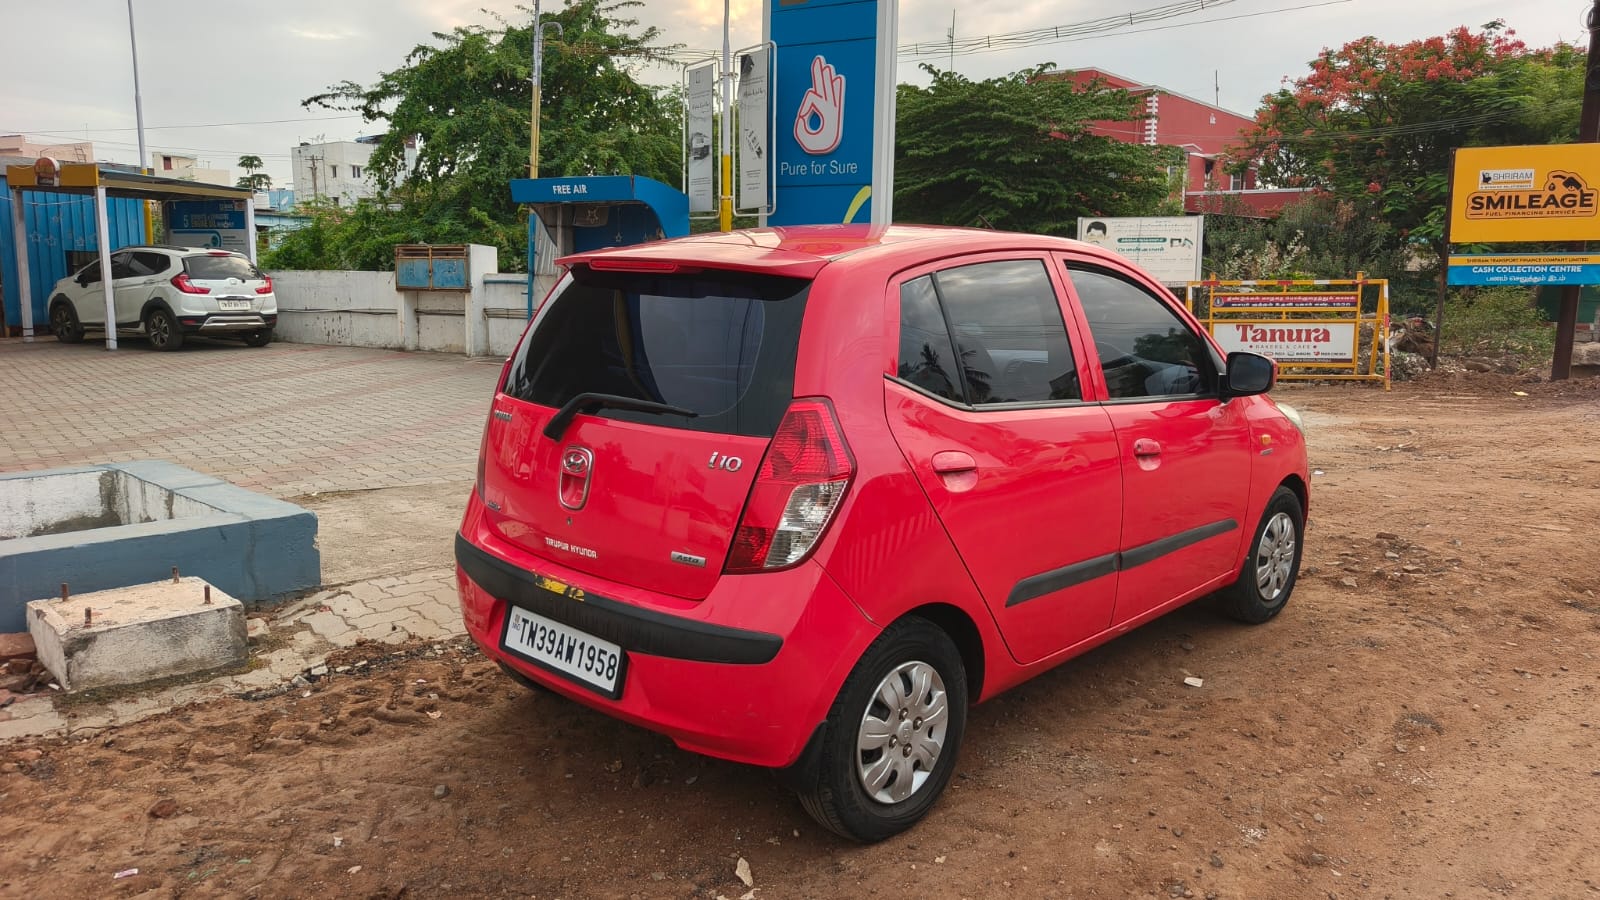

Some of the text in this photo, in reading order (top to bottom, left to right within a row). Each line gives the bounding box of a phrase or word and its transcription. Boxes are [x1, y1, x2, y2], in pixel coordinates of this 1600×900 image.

[780, 159, 858, 176] Pure for Sure
[1493, 172, 1533, 181] SHRIRAM
[552, 184, 588, 195] FREE AIR
[1470, 192, 1594, 210] SMILEAGE
[1235, 324, 1331, 343] Tanura
[708, 451, 743, 472] i10
[544, 536, 570, 552] TIRUPUR
[676, 554, 700, 564] Asta
[519, 617, 618, 681] TN39AW1958
